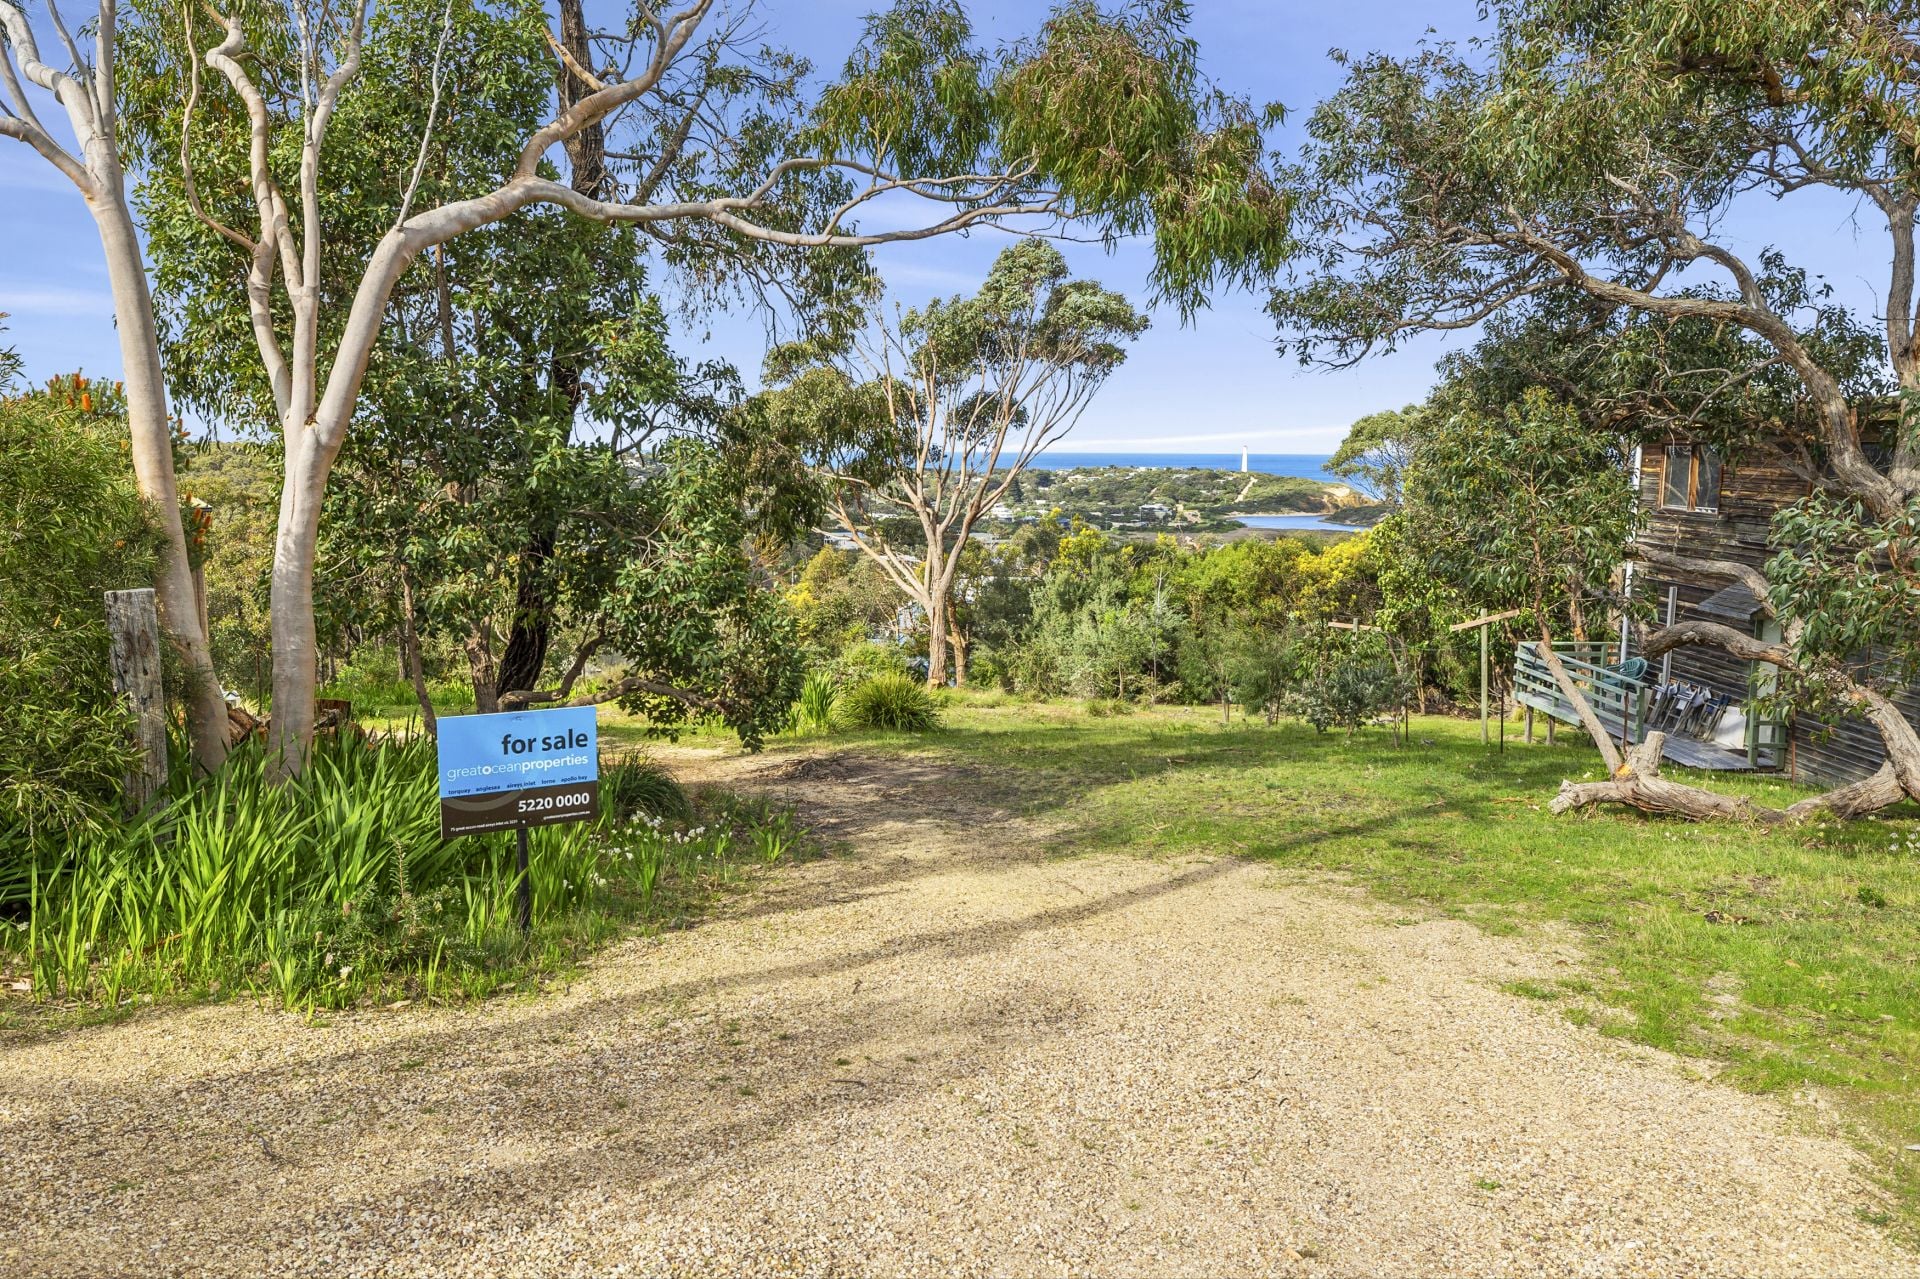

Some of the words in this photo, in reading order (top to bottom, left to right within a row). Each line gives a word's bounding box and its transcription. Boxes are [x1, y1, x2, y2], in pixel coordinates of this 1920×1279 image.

[501, 733, 537, 755] for
[541, 728, 589, 751] sale
[447, 754, 589, 782] greatoceanproperties
[448, 787, 471, 796] torquay
[475, 784, 500, 793] anglesea
[561, 775, 578, 783] apollo
[578, 773, 588, 781] bay
[518, 798, 553, 812] 5220
[555, 792, 590, 807] 0000
